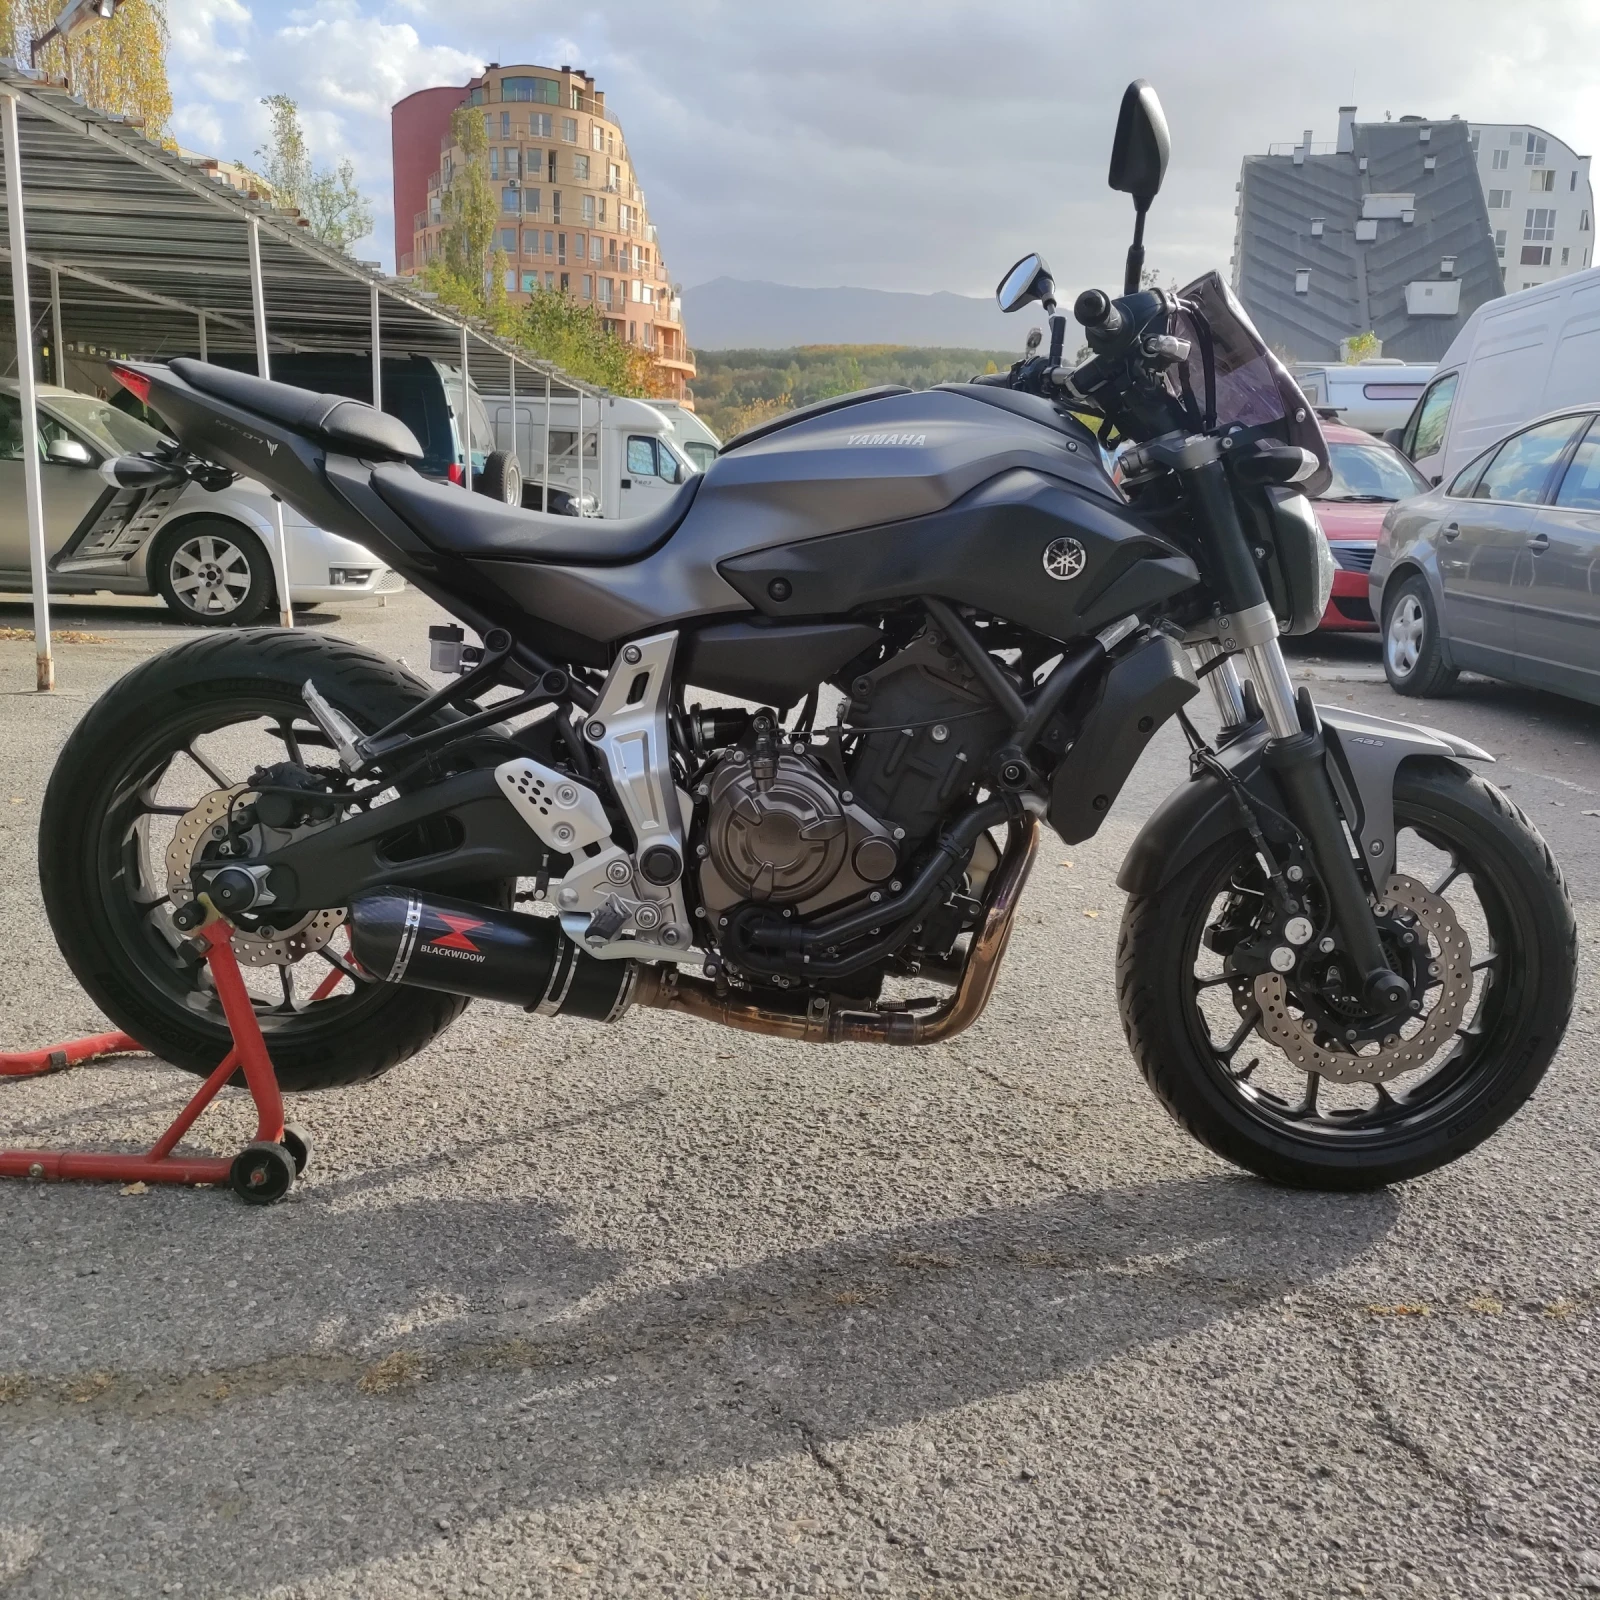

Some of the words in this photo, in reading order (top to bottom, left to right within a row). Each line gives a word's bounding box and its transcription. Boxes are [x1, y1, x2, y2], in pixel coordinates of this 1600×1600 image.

[215, 419, 264, 445] MT-07
[846, 433, 927, 446] YAMAHA
[1349, 736, 1386, 748] ABS
[420, 944, 486, 963] BLACKWIDOW
